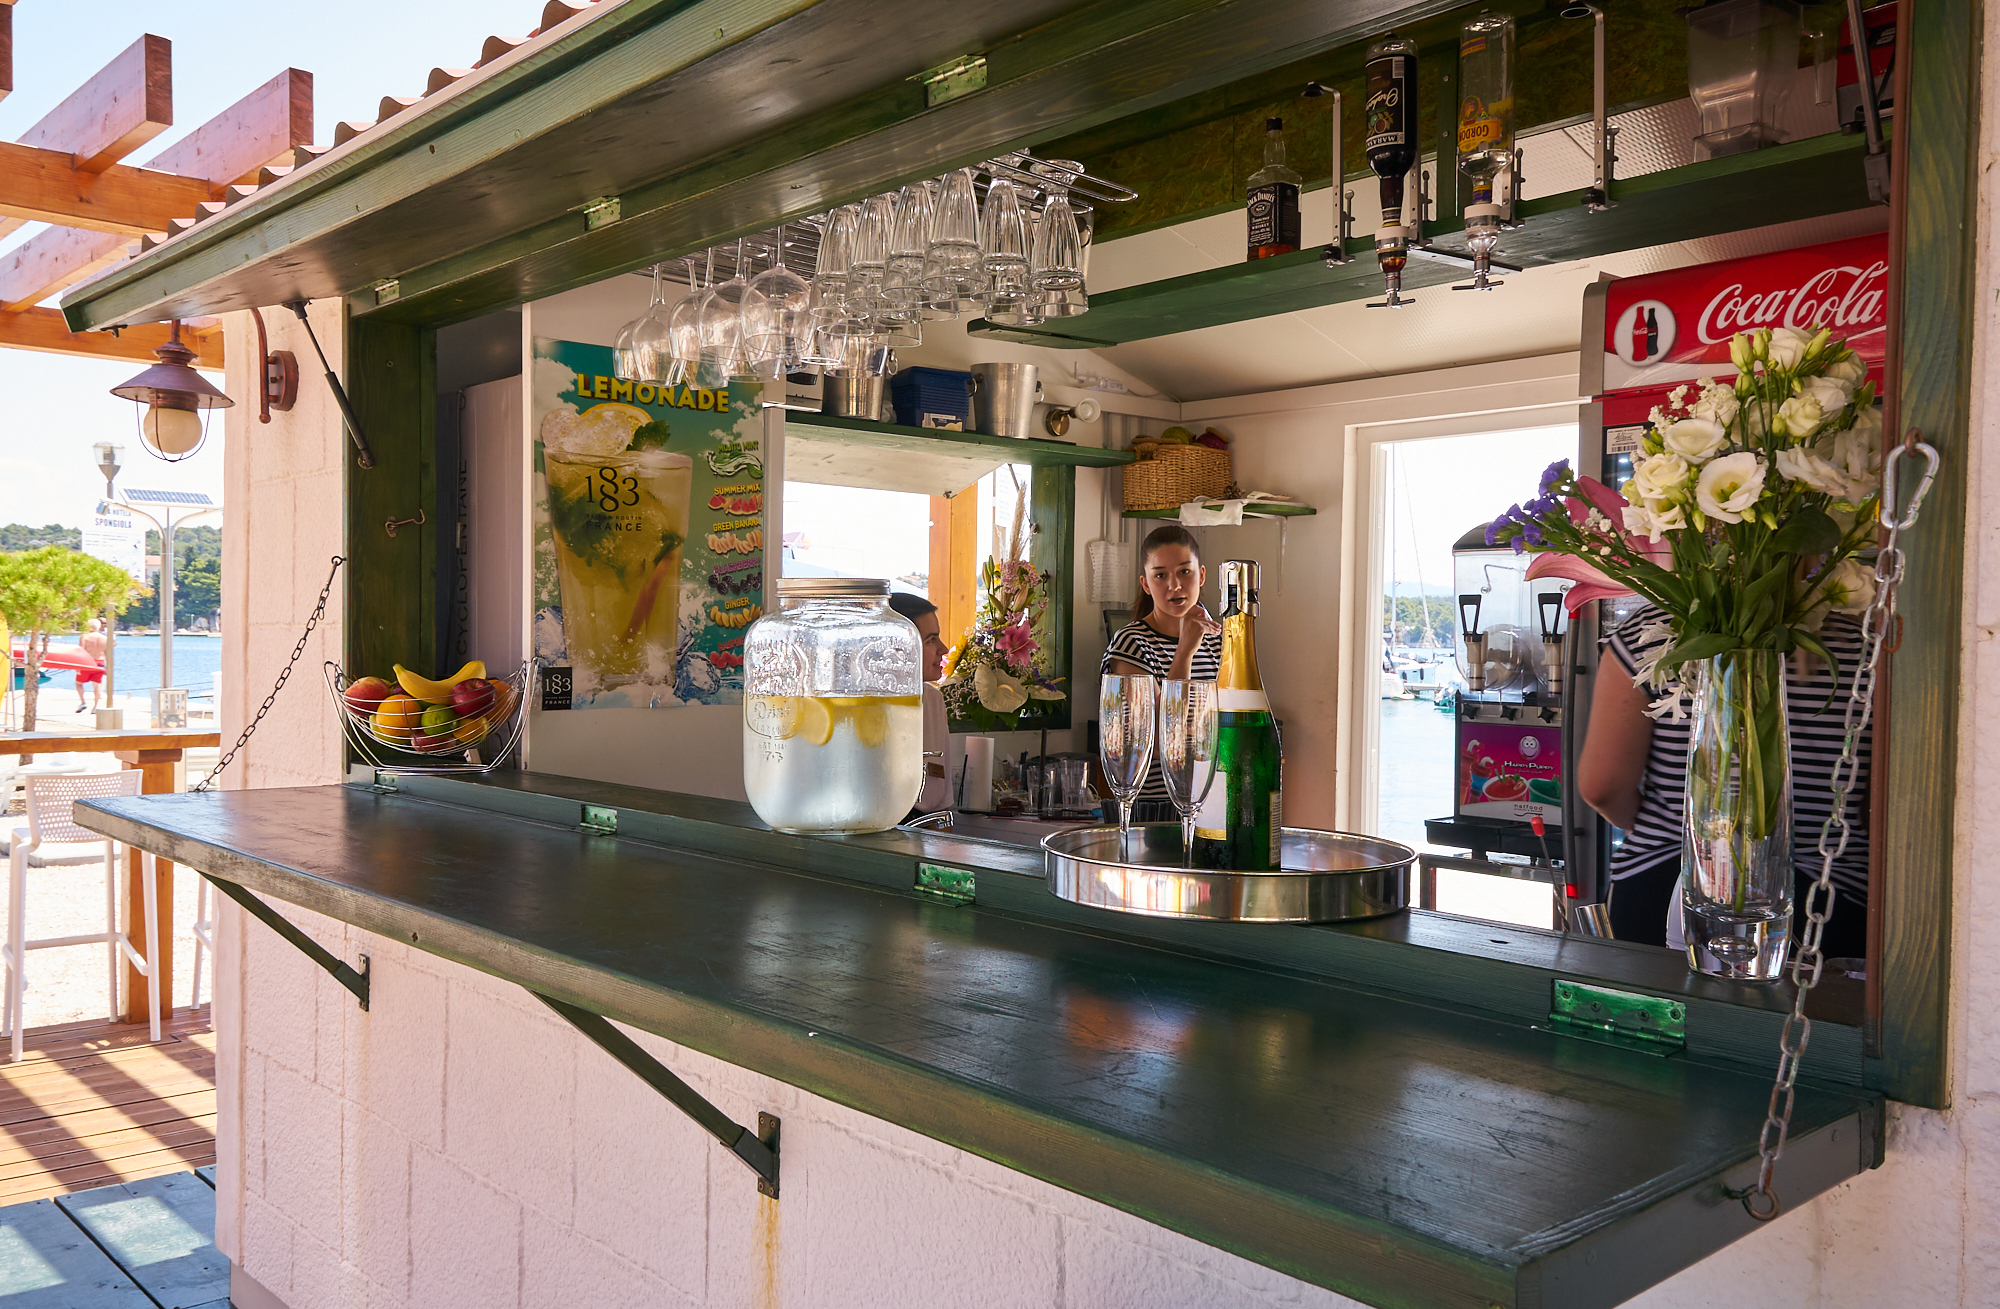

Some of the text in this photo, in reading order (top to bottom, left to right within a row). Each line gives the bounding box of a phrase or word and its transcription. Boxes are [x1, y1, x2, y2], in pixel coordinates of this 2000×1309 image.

[1697, 260, 1889, 345] Coca-Cola
[577, 373, 729, 413] LEMONADE
[742, 440, 759, 452] MINT
[714, 482, 761, 496] SUMMER MIX
[95, 517, 132, 528] SPONGIOLA
[586, 521, 642, 532] FRANCE
[712, 518, 761, 532] GREEN BANANA
[714, 557, 761, 575] BLACKBERRY
[724, 597, 750, 609] GINGER
